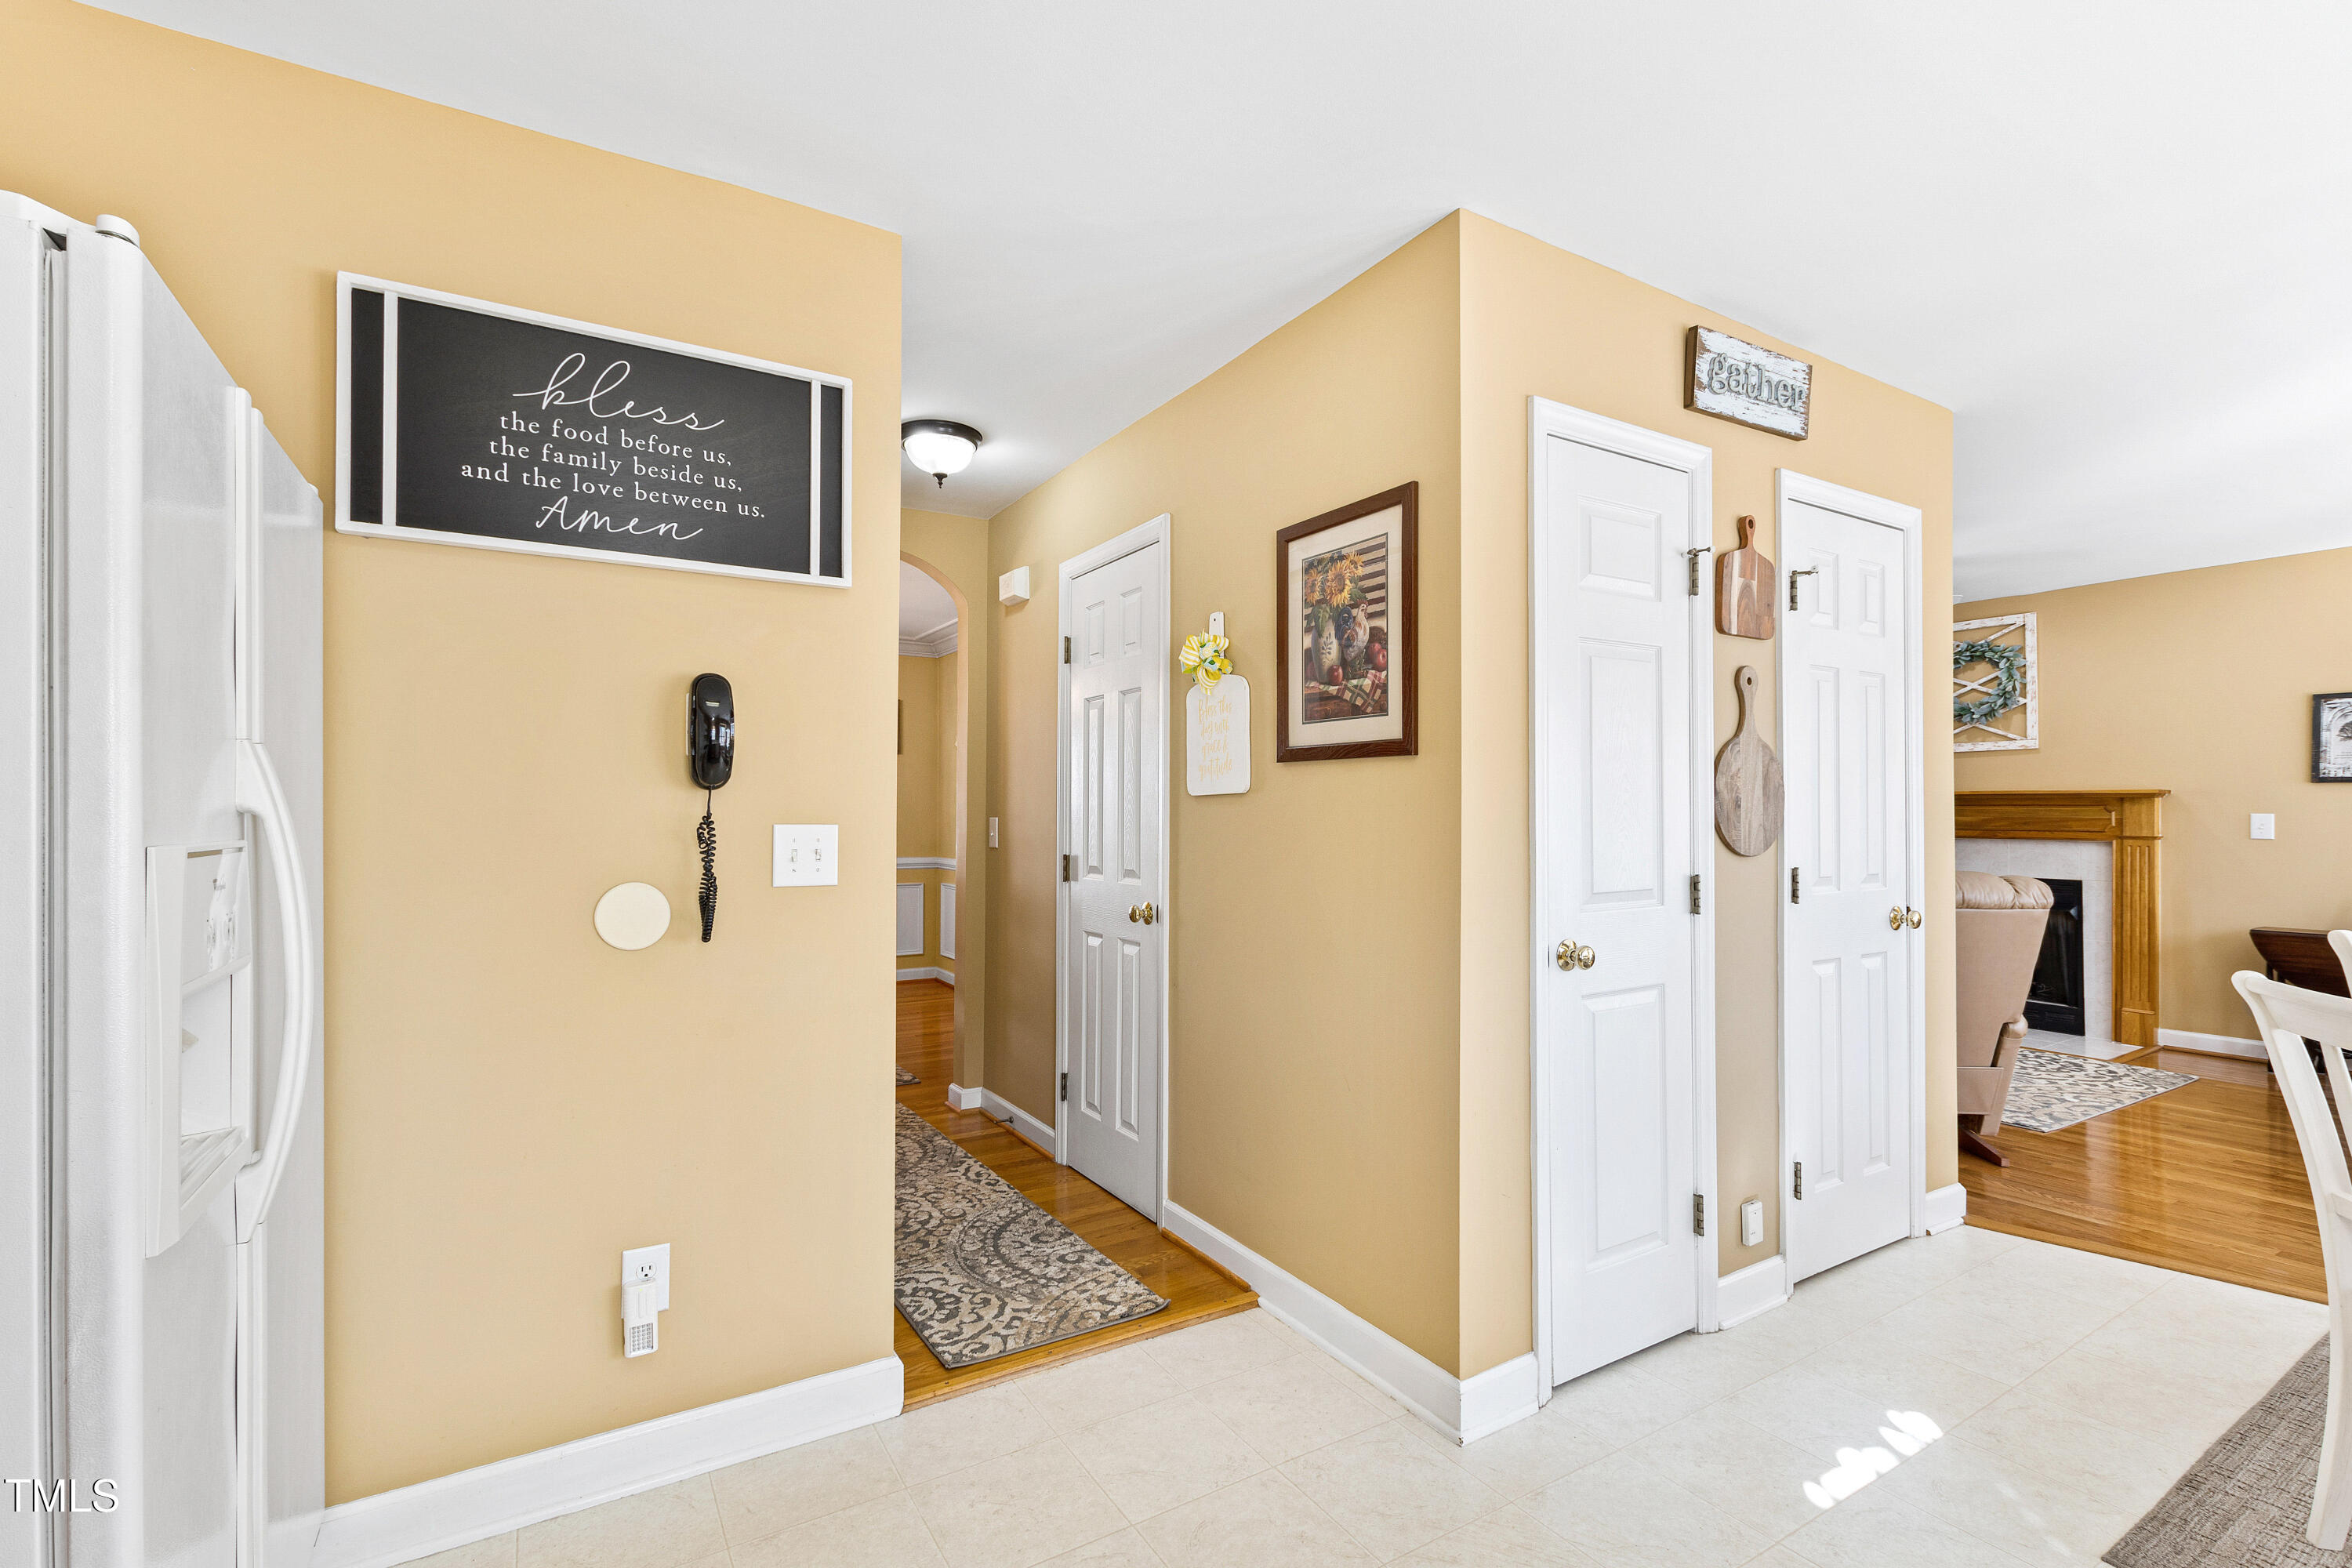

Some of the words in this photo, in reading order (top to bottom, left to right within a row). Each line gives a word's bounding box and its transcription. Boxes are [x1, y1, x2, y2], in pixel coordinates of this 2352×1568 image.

[512, 352, 725, 431] bless
[489, 435, 530, 459] the
[541, 442, 622, 477] family
[633, 456, 704, 485] beside
[713, 475, 742, 492] us,
[499, 410, 540, 434] the
[551, 418, 609, 446] food
[619, 428, 693, 459] before
[702, 449, 731, 467] us,
[461, 462, 510, 483] and
[521, 466, 561, 490] the
[572, 472, 624, 499] love
[633, 481, 728, 514] between
[737, 503, 765, 518] us.
[535, 495, 704, 540] Amen
